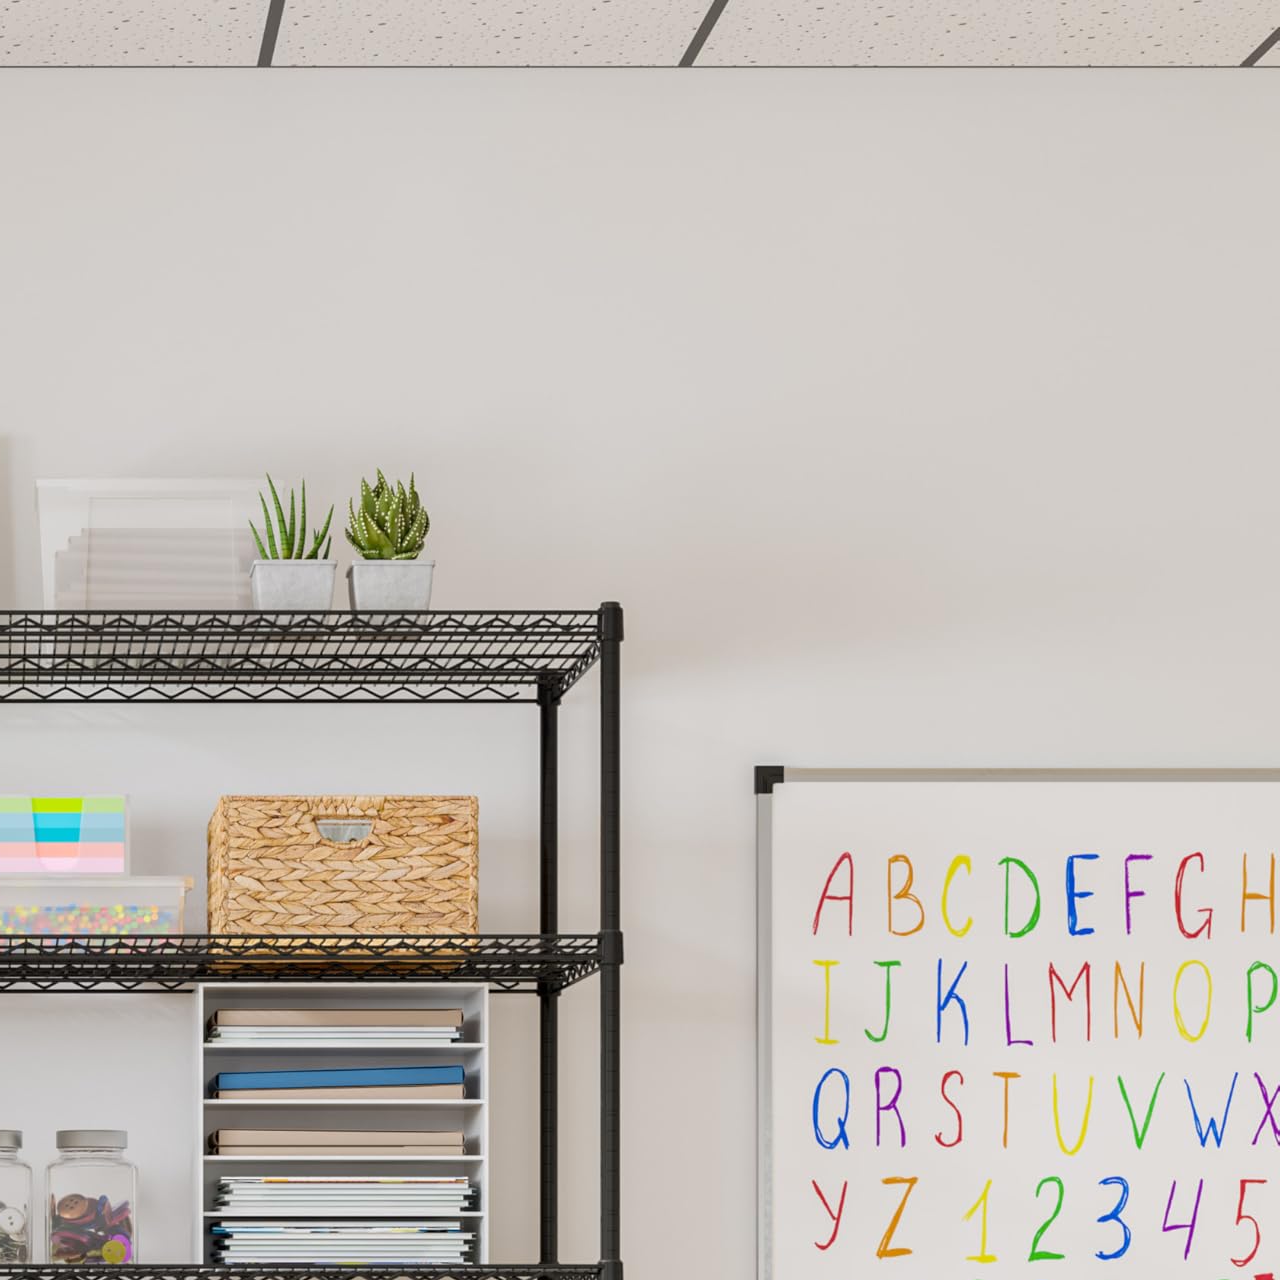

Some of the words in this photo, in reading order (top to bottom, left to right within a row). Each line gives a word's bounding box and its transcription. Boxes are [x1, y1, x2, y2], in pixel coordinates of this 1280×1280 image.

[813, 851, 854, 936] A
[887, 853, 926, 937] B
[940, 854, 974, 939] C
[997, 855, 1041, 938] D
[1065, 853, 1100, 936] E
[1124, 853, 1153, 935] F
[1173, 851, 1213, 940] G
[1240, 852, 1276, 935] H
[812, 959, 841, 1046] I
[864, 960, 902, 1043] J
[936, 958, 969, 1046] K
[1004, 963, 1034, 1047] L
[1048, 961, 1091, 1043] M
[1113, 960, 1145, 1040] N
[1172, 959, 1213, 1044] O
[1245, 960, 1279, 1043] P
[812, 1067, 851, 1150] Q
[874, 1066, 907, 1148] R
[934, 1070, 965, 1148] S
[992, 1071, 1022, 1150] T
[1052, 1072, 1095, 1157] U
[1117, 1072, 1166, 1150] V
[1184, 1072, 1239, 1149] W
[1252, 1072, 1280, 1146] X
[875, 1175, 919, 1260] Z
[962, 1178, 999, 1264] 1
[1028, 1176, 1066, 1263] 2
[1095, 1176, 1132, 1261] 3
[1162, 1178, 1204, 1261] 4
[1231, 1178, 1268, 1268] 5
